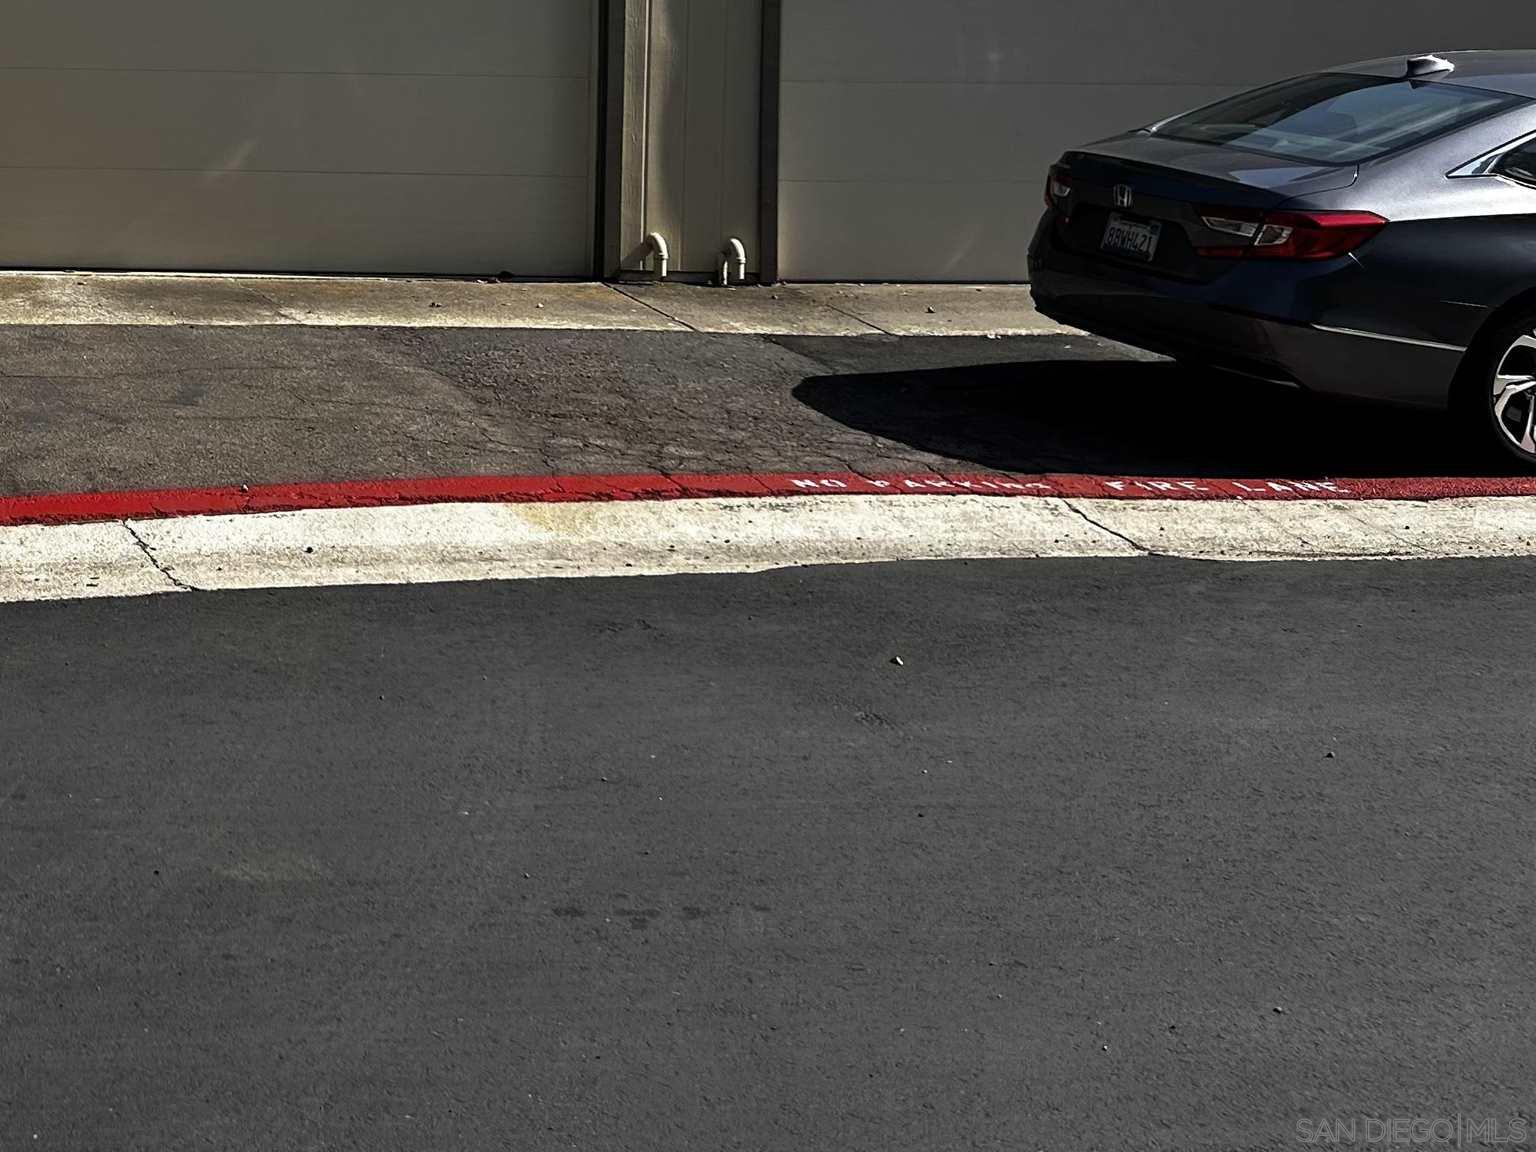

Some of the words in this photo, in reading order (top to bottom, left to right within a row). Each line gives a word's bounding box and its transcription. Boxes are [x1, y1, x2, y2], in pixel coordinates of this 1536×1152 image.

[789, 479, 848, 488] NO
[1105, 481, 1209, 491] FIRE
[1231, 481, 1349, 493] LANE
